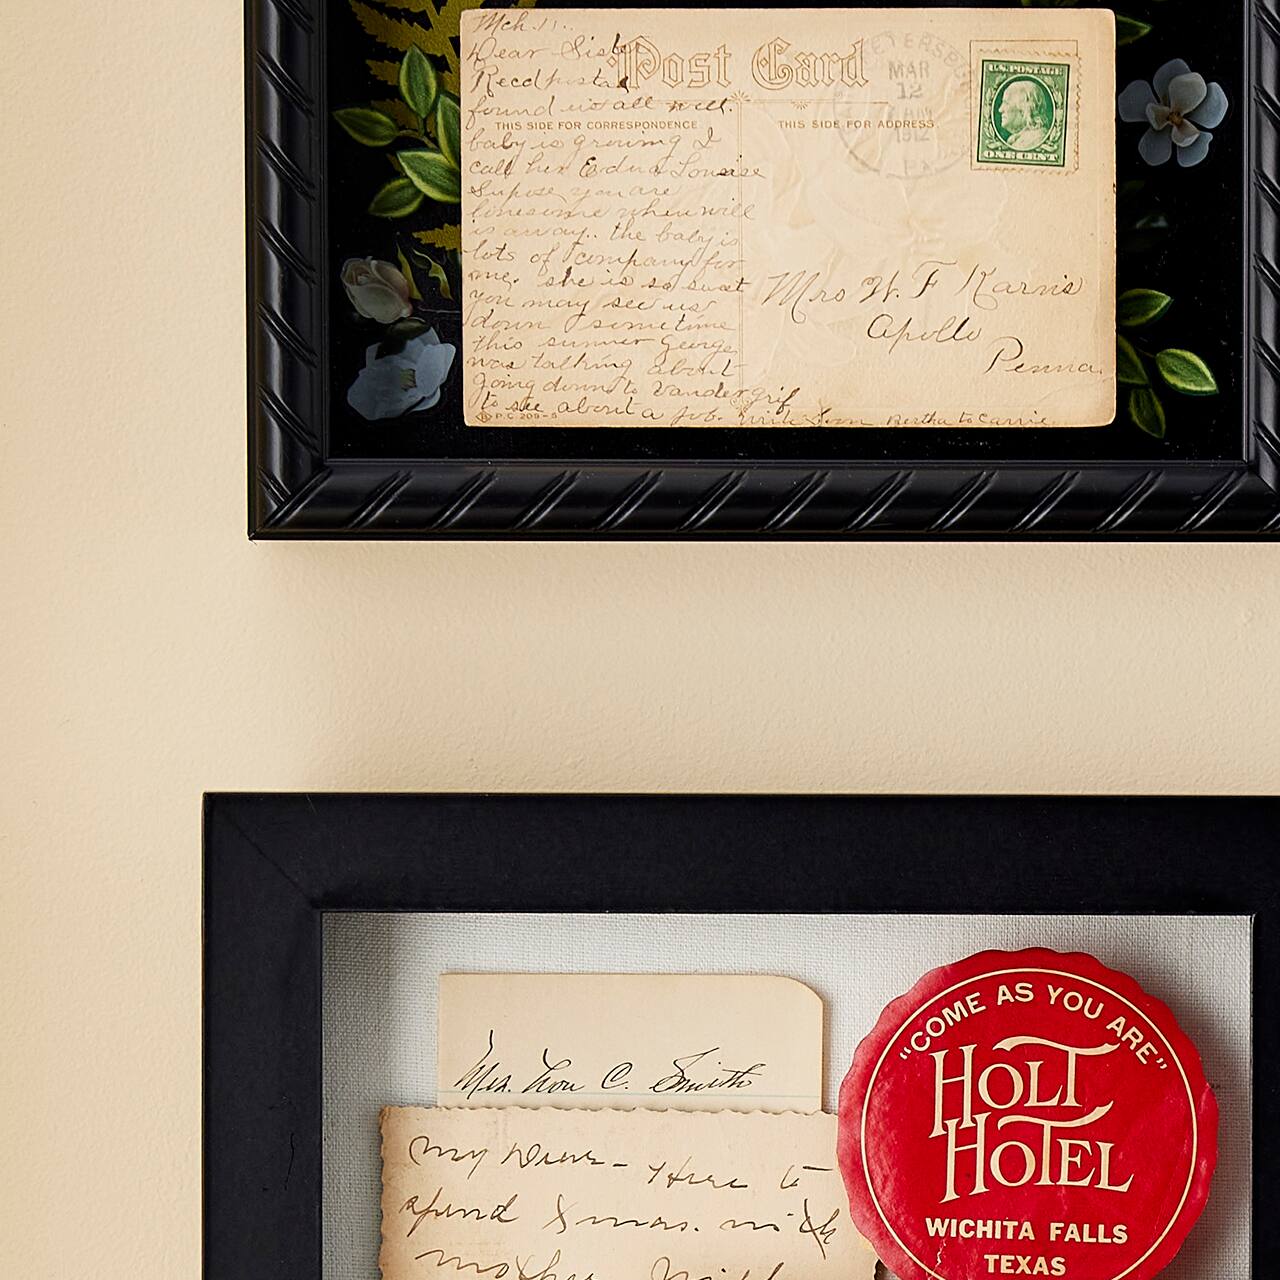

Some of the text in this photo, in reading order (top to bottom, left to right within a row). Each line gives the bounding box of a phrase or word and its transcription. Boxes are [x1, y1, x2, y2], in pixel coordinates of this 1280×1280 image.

[467, 37, 544, 68] Dear
[607, 35, 869, 91] Post Card
[888, 60, 930, 81] MAR
[897, 82, 923, 99] 12
[466, 95, 655, 130] found all
[495, 121, 698, 130] THIS SIDE FOR CORRESPONDENCE
[778, 120, 806, 129] THIS
[811, 120, 839, 129] SIDE
[846, 120, 872, 129] FOR
[469, 128, 526, 152] baby
[470, 158, 517, 178] call
[610, 216, 646, 242] the
[656, 222, 714, 250] baby
[464, 239, 515, 262] lots
[530, 242, 560, 276] of
[600, 269, 634, 286] is
[465, 289, 515, 322] you
[521, 299, 590, 328] may
[602, 297, 656, 311] see
[762, 269, 846, 324] Mrs
[470, 309, 551, 330] down
[867, 313, 982, 354] Apollo
[472, 331, 523, 352] this
[996, 981, 1036, 1006] AS
[1046, 984, 1106, 1020] YOU
[600, 1062, 634, 1091] C.
[648, 1046, 767, 1094] Smith
[928, 1035, 1121, 1139] HOLT
[938, 1100, 1135, 1204] HOTEL
[399, 1186, 520, 1238] spend
[720, 1198, 840, 1261] with
[925, 1217, 1129, 1245] WICHITA FALLS
[983, 1253, 1067, 1277] TEXAS
